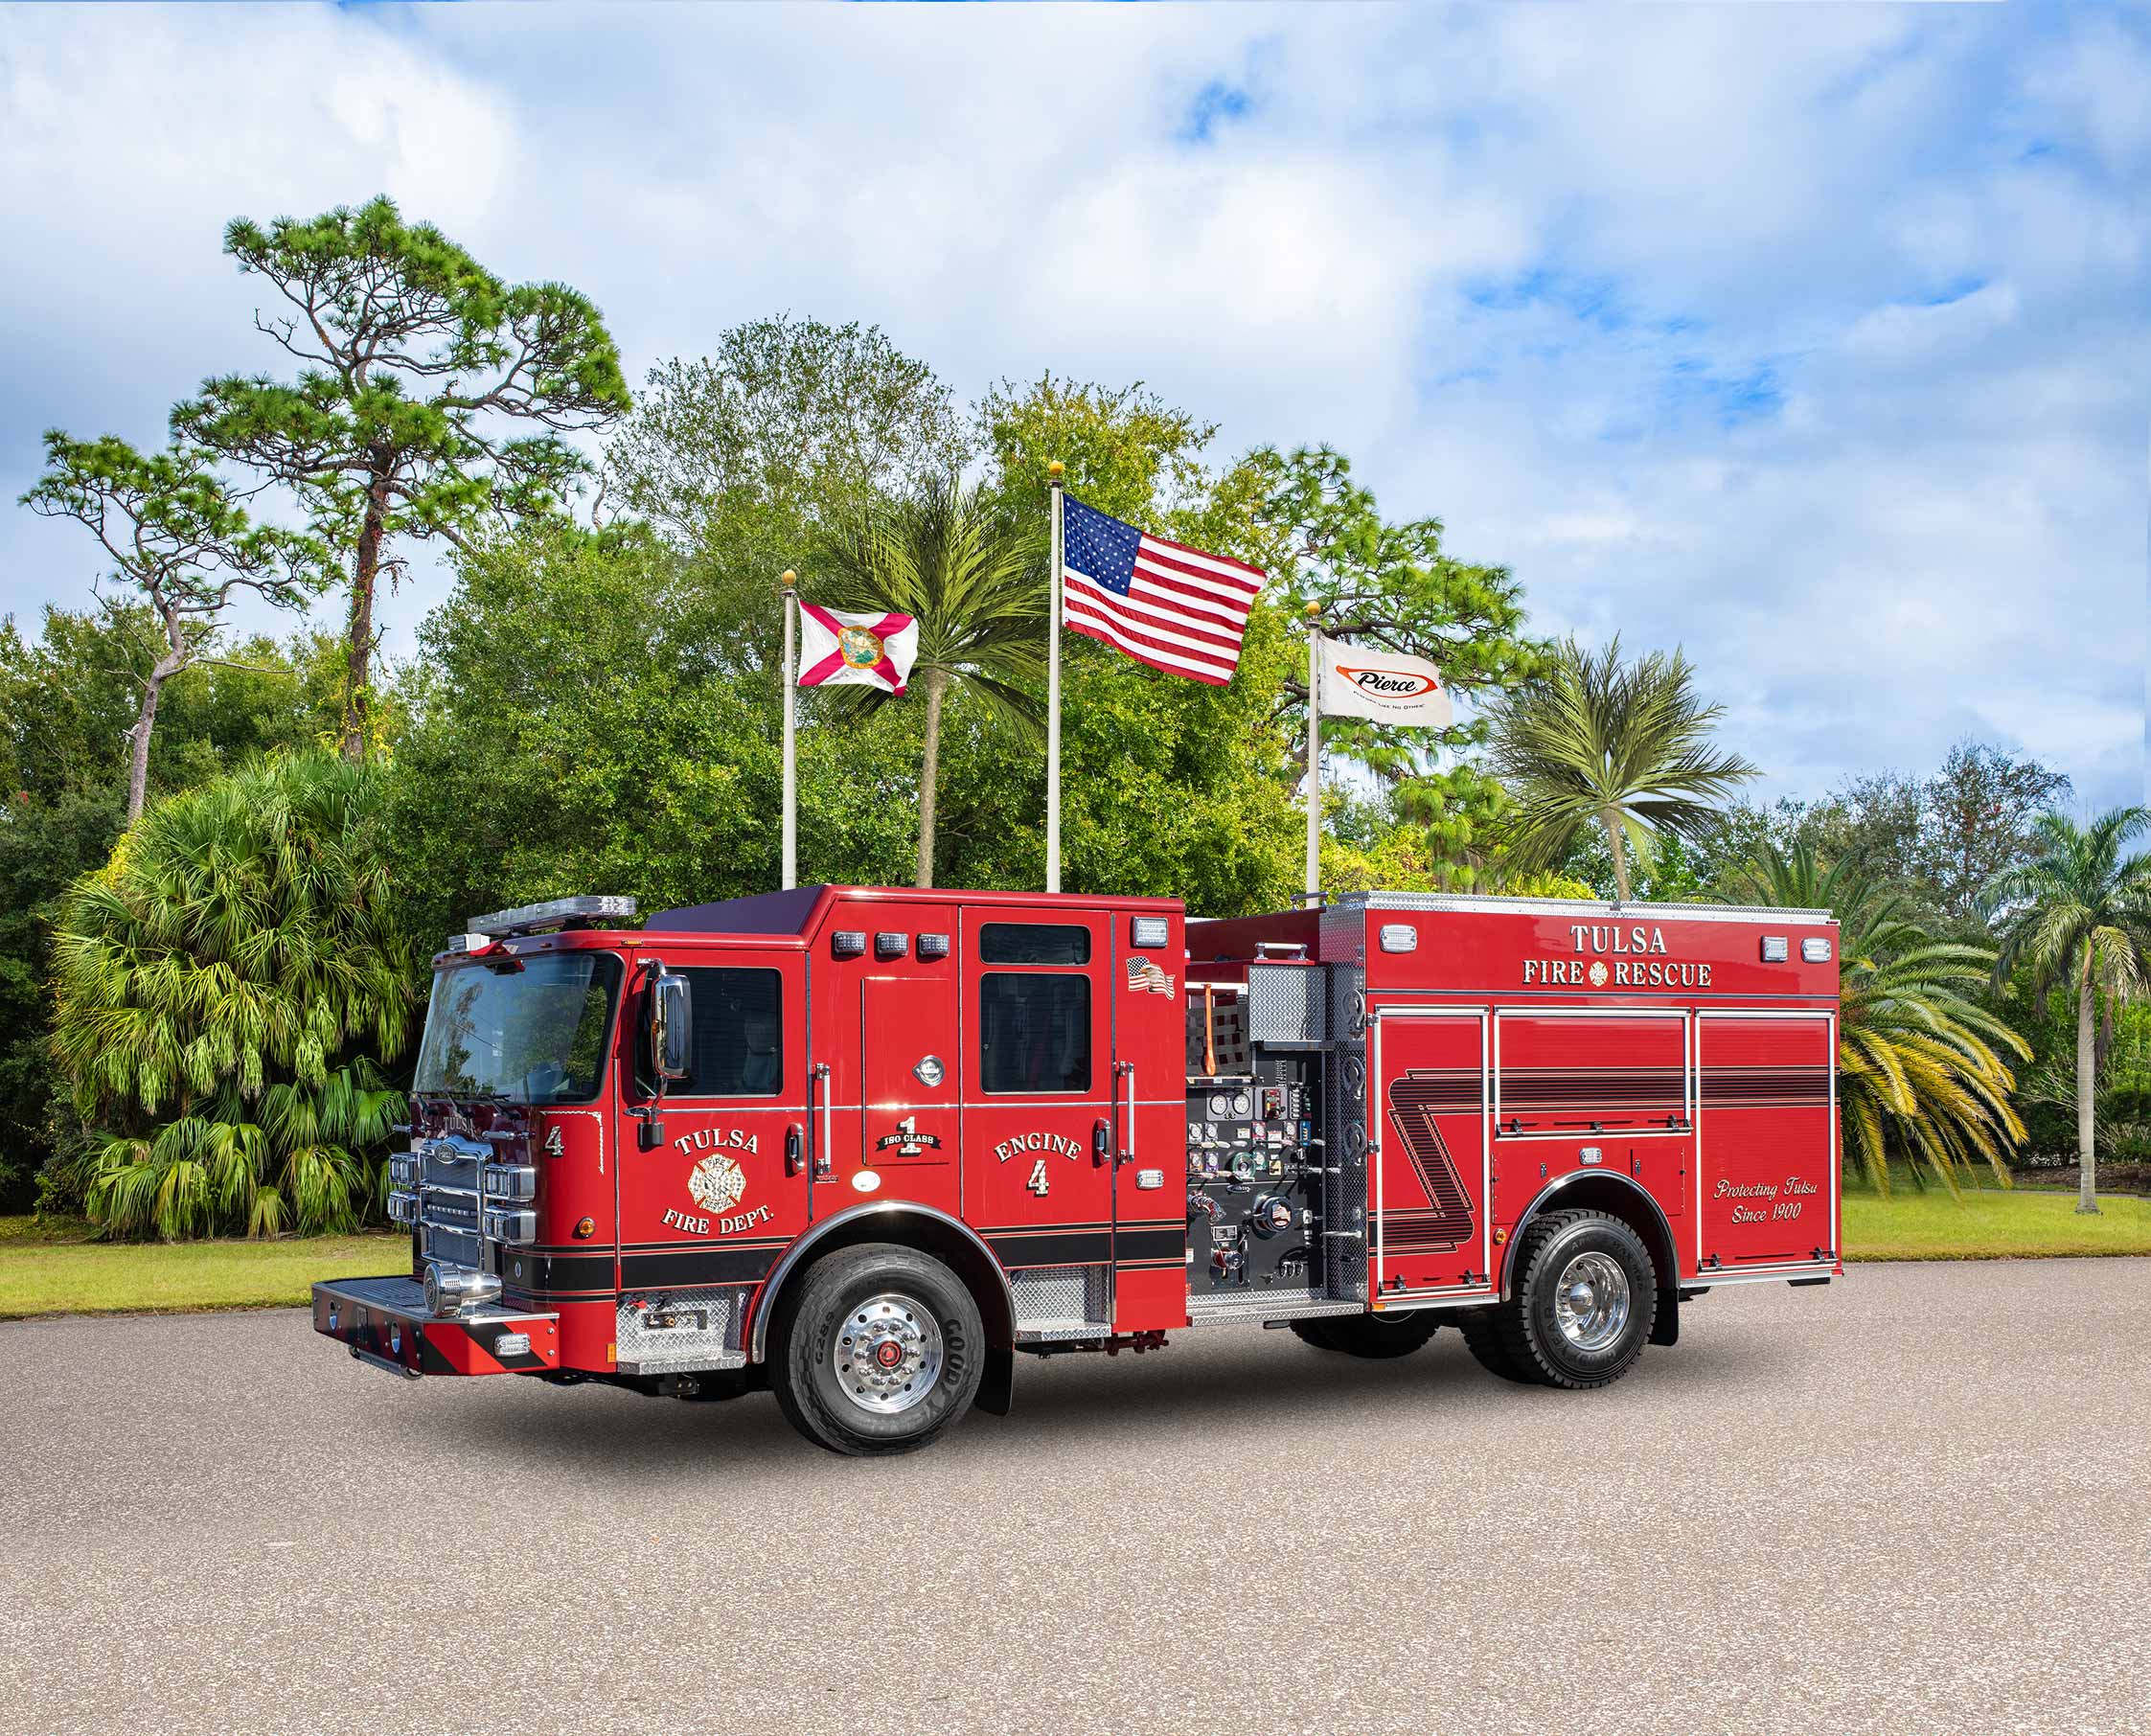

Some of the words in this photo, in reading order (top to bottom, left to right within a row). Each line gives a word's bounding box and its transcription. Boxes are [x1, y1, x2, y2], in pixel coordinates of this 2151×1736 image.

[1358, 672, 1416, 692] Pierce
[1570, 925, 1667, 954] TULSA
[1522, 960, 1584, 985] FIRE
[1613, 961, 1712, 987] RESCUE
[543, 1125, 565, 1157] 4
[674, 1129, 759, 1156] TULSA
[883, 1135, 902, 1146] ISO
[904, 1133, 934, 1145] CLASS
[994, 1132, 1082, 1164] ENGINE
[707, 1157, 726, 1167] FIRE
[1026, 1159, 1050, 1198] 4
[1713, 1178, 1778, 1201] Protecting
[1783, 1176, 1818, 1196] Tulsa
[661, 1209, 709, 1234] FIRE
[719, 1205, 774, 1234] DEPT.
[1731, 1204, 1768, 1224] Since
[1771, 1202, 1802, 1222] 1900
